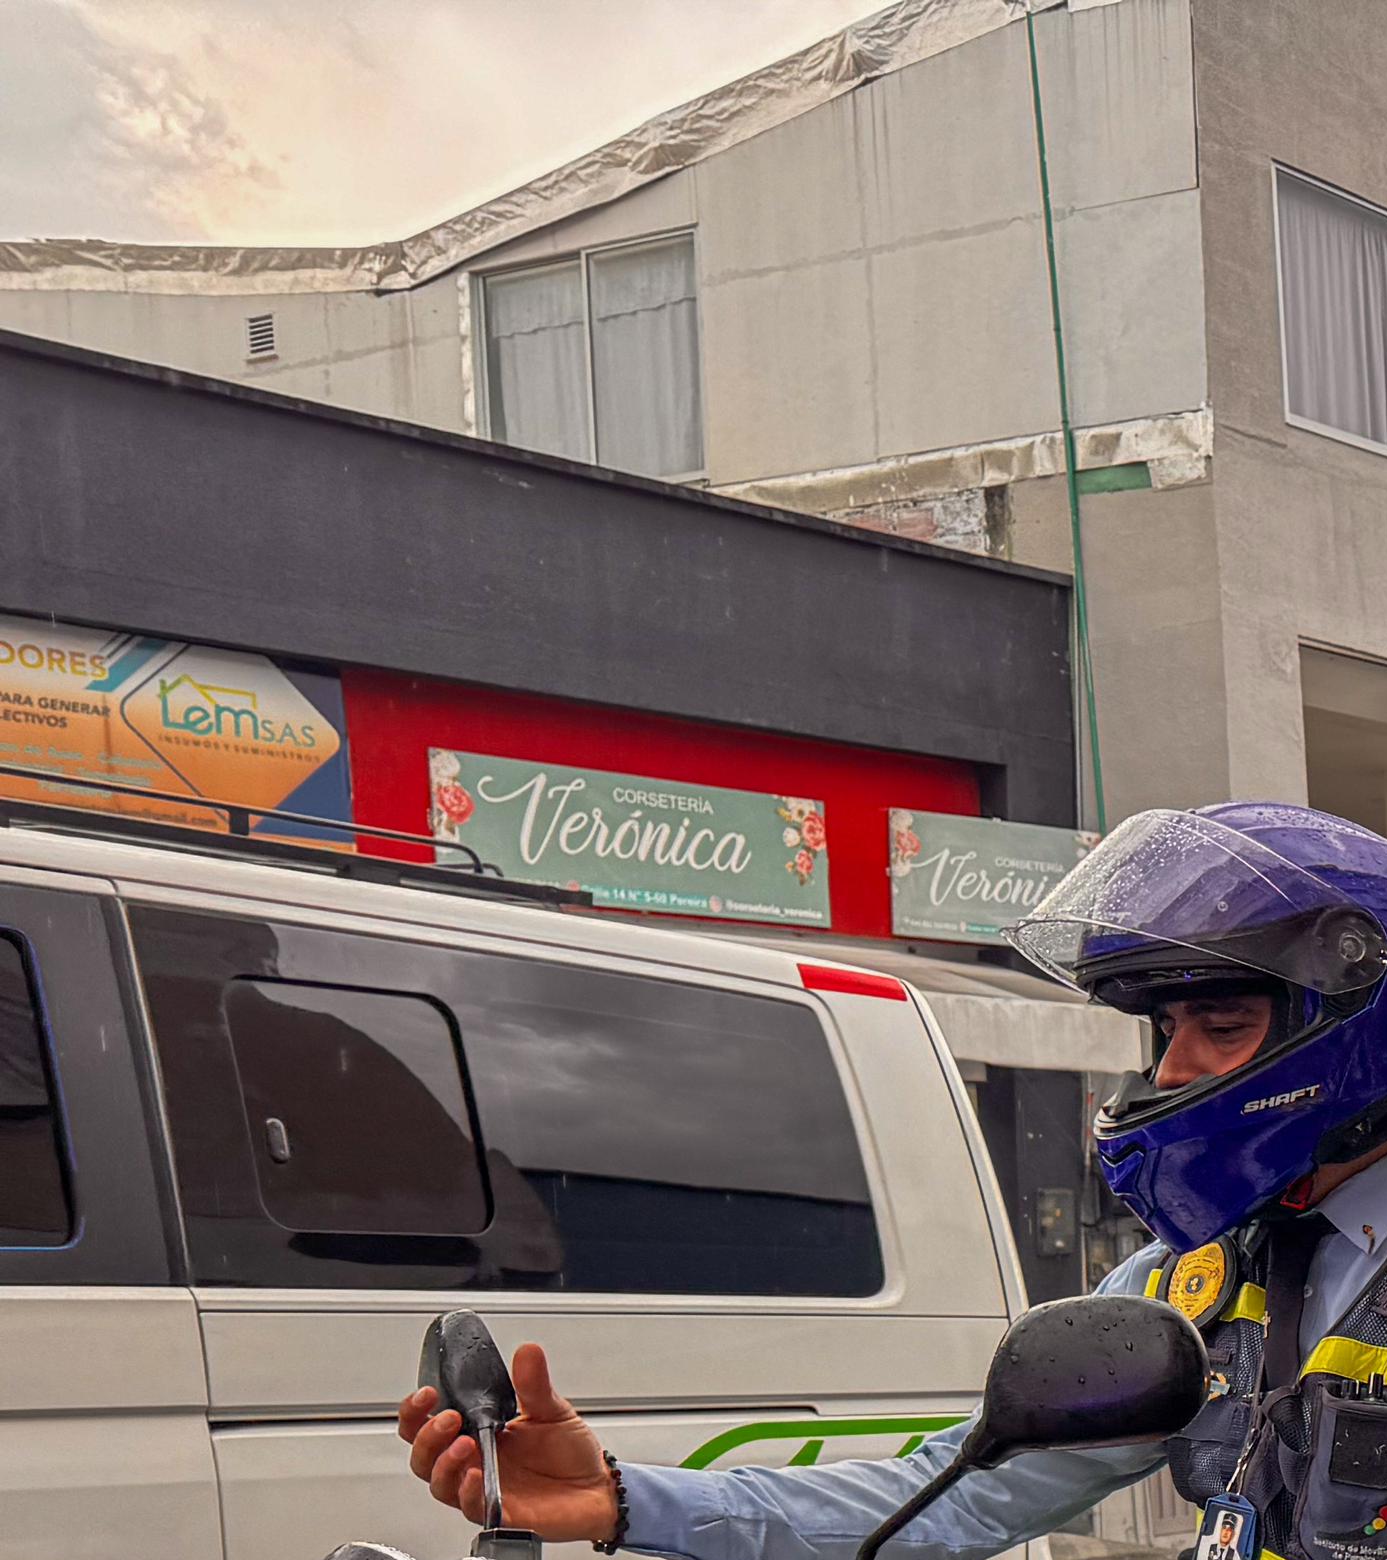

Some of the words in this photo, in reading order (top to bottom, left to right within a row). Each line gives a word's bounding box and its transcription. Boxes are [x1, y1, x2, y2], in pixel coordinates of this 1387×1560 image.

[0, 707, 68, 729] ECTIVOS
[477, 772, 752, 874] Verónica
[1243, 1084, 1320, 1114] SHAFT
